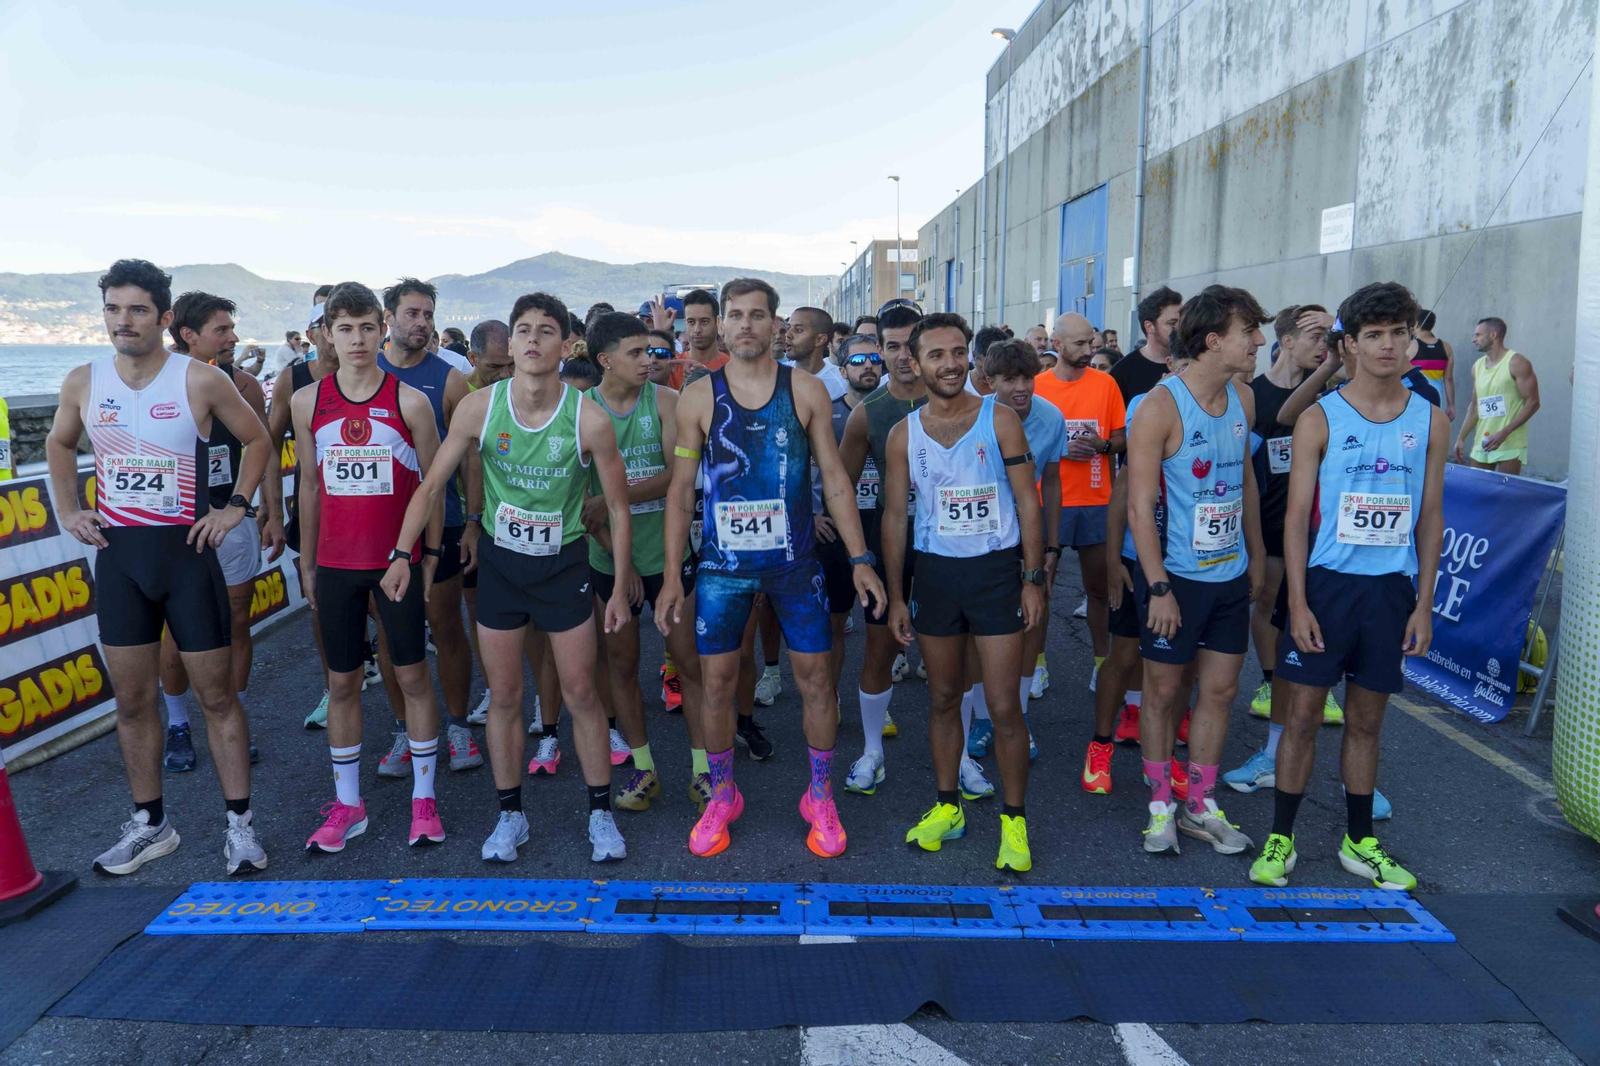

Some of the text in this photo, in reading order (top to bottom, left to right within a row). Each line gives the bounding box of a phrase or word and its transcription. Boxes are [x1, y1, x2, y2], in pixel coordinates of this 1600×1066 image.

[1485, 402, 1498, 412] 36
[325, 448, 391, 457] 5KM POR MAURI
[106, 457, 124, 466] 5KM
[125, 458, 144, 467] POR
[491, 456, 571, 477] SAN MIGUEL
[335, 462, 378, 480] 501
[115, 472, 165, 492] 524
[506, 475, 551, 491] MARÍN
[940, 489, 954, 498] 5KM
[955, 489, 972, 497] POR
[973, 485, 997, 496] MAURI
[1344, 495, 1364, 504] 5KM
[1366, 496, 1385, 505] POR
[499, 505, 516, 517] 5KM
[517, 511, 533, 521] POR
[948, 500, 990, 520] 515
[1199, 506, 1217, 514] 5KM
[730, 516, 773, 535] 541
[1207, 514, 1238, 536] 510
[1353, 510, 1402, 530] 507
[508, 521, 551, 543] 611
[1460, 666, 1472, 680] en
[1476, 671, 1511, 694] eurobanan
[0, 654, 103, 735] GADIS
[1473, 681, 1505, 707] Galicia
[650, 886, 749, 895] CRONOTEC
[856, 888, 954, 897] CRONOTEC
[1061, 891, 1157, 899] CRONOTEC
[1263, 892, 1360, 901] CRONOTEC
[384, 900, 578, 912] CRONOTEC
